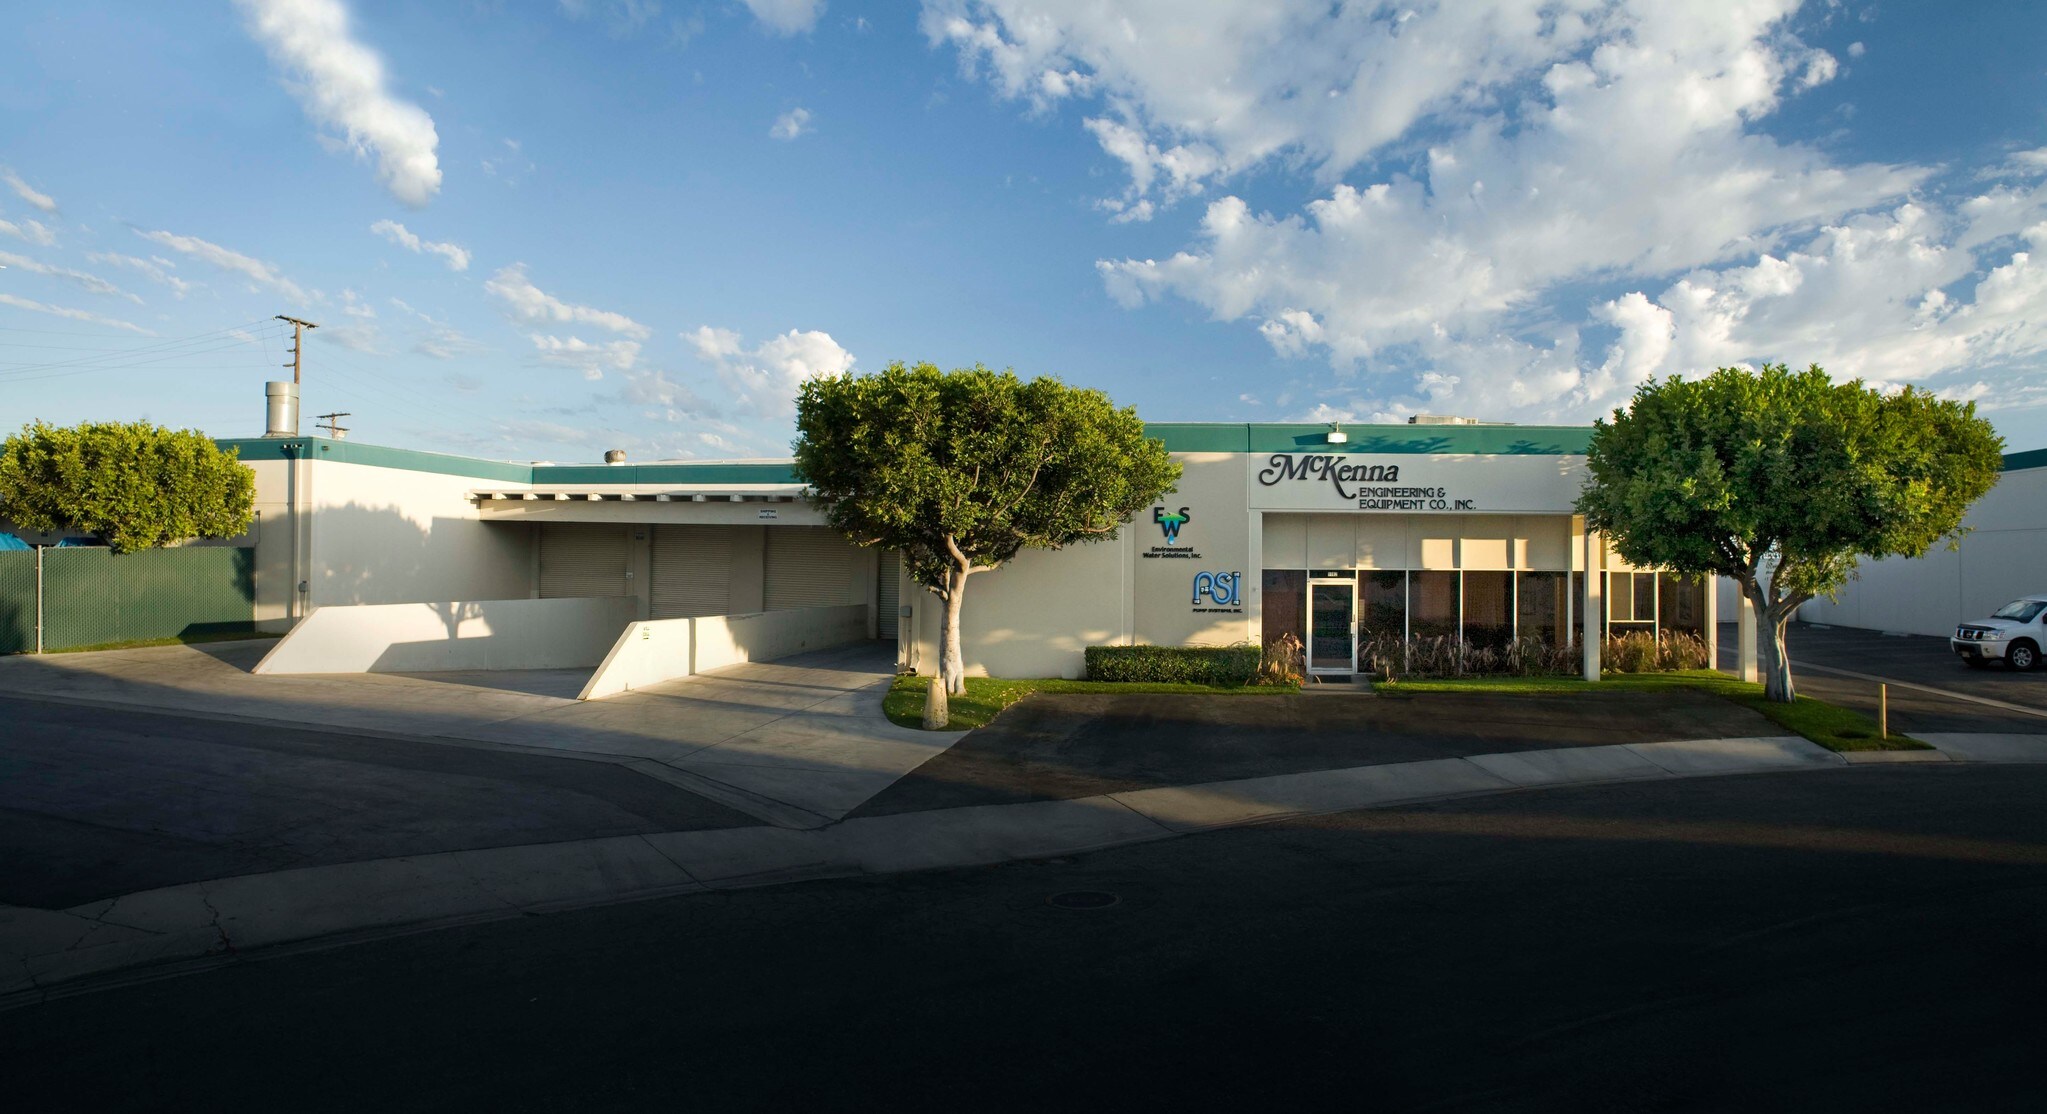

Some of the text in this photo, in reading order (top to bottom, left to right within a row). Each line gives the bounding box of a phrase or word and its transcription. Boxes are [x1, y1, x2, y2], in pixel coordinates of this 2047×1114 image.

[1258, 454, 1399, 499] McKenna
[1359, 487, 1446, 498] ENGINEERING &
[1359, 499, 1477, 511] EQUIPMENT CO., INC.
